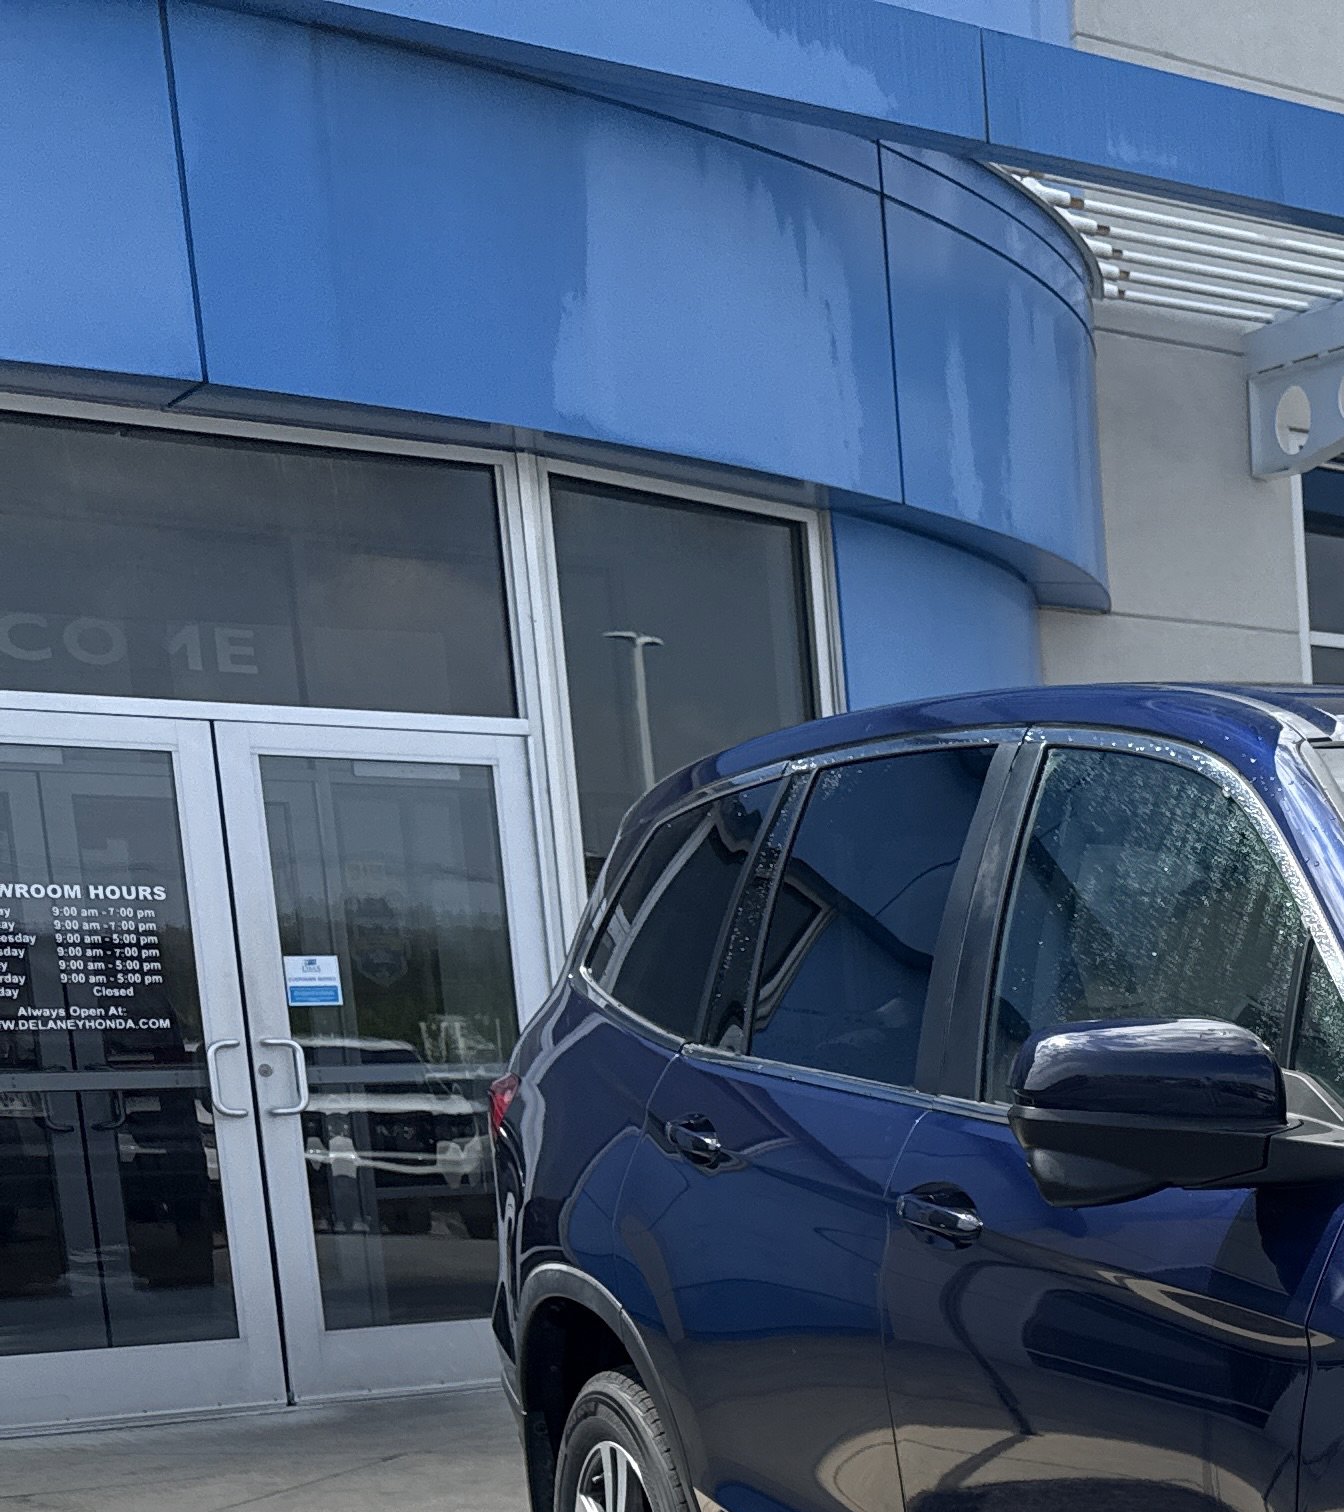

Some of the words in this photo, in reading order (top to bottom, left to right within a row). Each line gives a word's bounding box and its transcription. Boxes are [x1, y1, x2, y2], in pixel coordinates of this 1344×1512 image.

[88, 885, 167, 901] HOURS
[52, 906, 78, 918] 9:00
[80, 908, 99, 917] am
[108, 907, 134, 918] 7:00
[137, 909, 155, 919] pm
[53, 919, 79, 930] 9:00
[82, 921, 101, 931] am
[138, 922, 157, 933] pm
[55, 933, 81, 944] 9:00
[83, 935, 102, 944] am
[112, 933, 137, 944] 5:00
[140, 935, 159, 947] pm
[56, 946, 83, 957] 9:00
[85, 948, 104, 957] am
[114, 946, 138, 958] 7:00
[141, 949, 160, 960] pm
[58, 960, 84, 970] 9:00
[87, 961, 105, 970] am
[115, 960, 140, 970] 5:00
[142, 962, 162, 973] pm
[60, 973, 86, 983] 9:00
[88, 975, 107, 983] am
[117, 973, 142, 984] 5:00
[144, 975, 164, 986] pm
[93, 986, 135, 997] Closed
[17, 1006, 67, 1019] Always
[69, 1006, 106, 1019] Open
[108, 1005, 128, 1017] At:
[0, 1018, 171, 1031] W.DELANEYHONDA.COM
